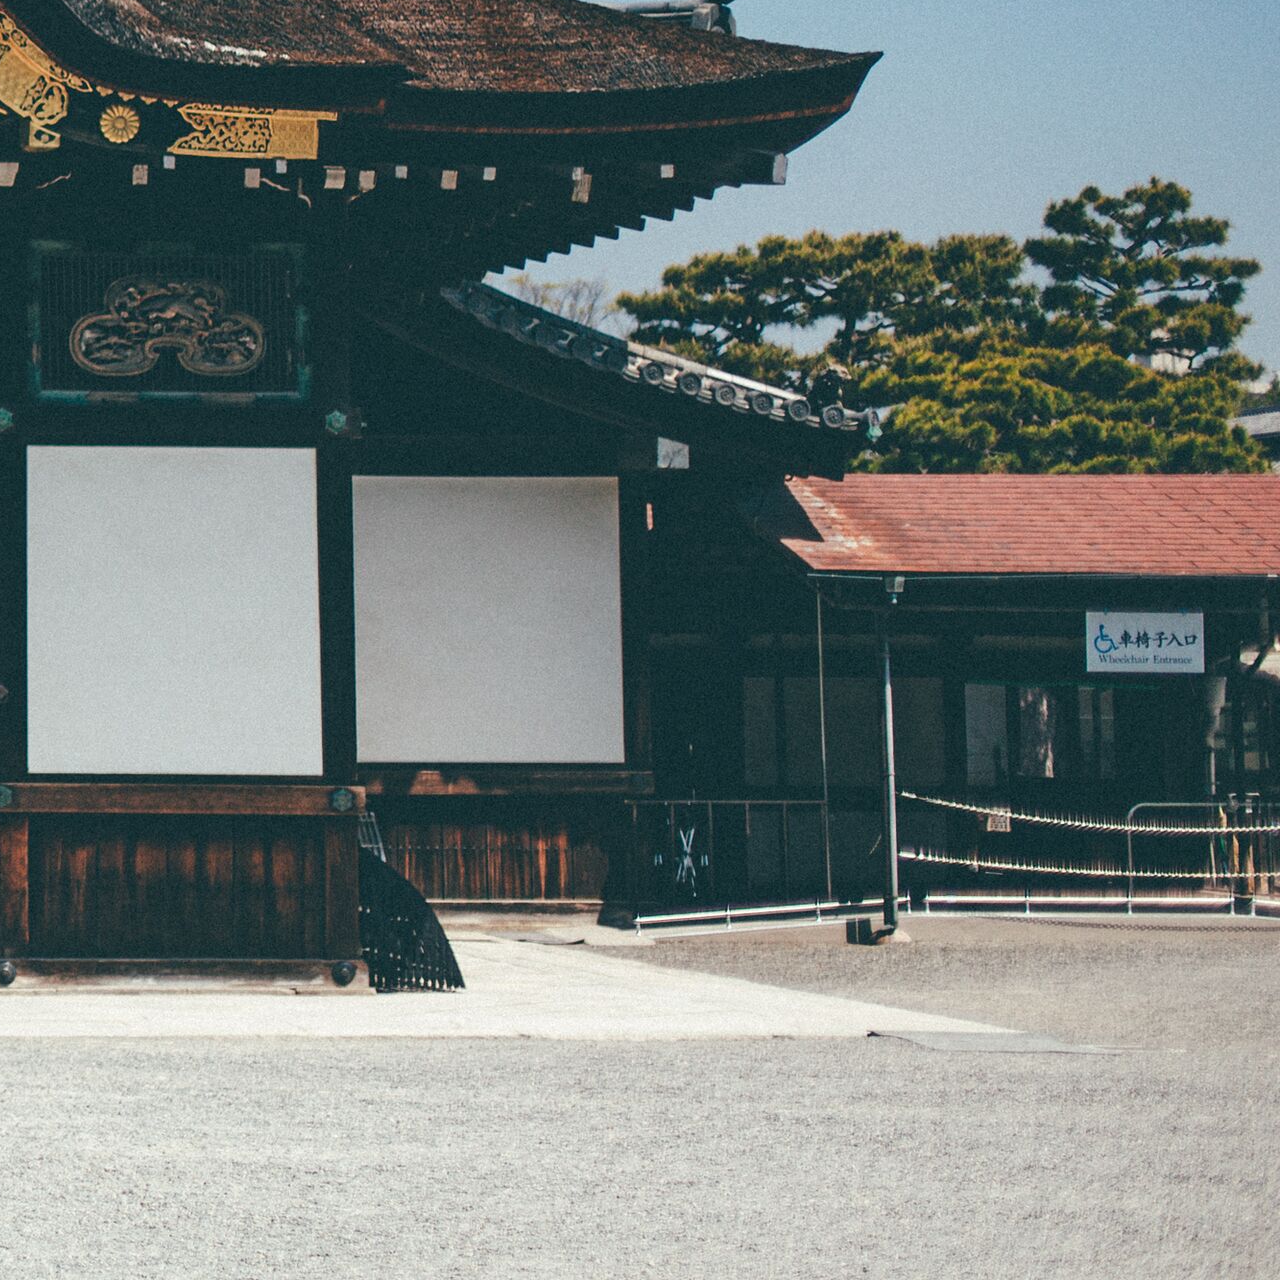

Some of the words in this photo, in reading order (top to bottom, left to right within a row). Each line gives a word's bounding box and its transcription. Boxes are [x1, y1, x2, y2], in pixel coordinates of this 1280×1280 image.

[1118, 630, 1198, 649] 車椅子入口
[1098, 654, 1149, 665] Wheelchair
[1153, 655, 1193, 665] Entrance
